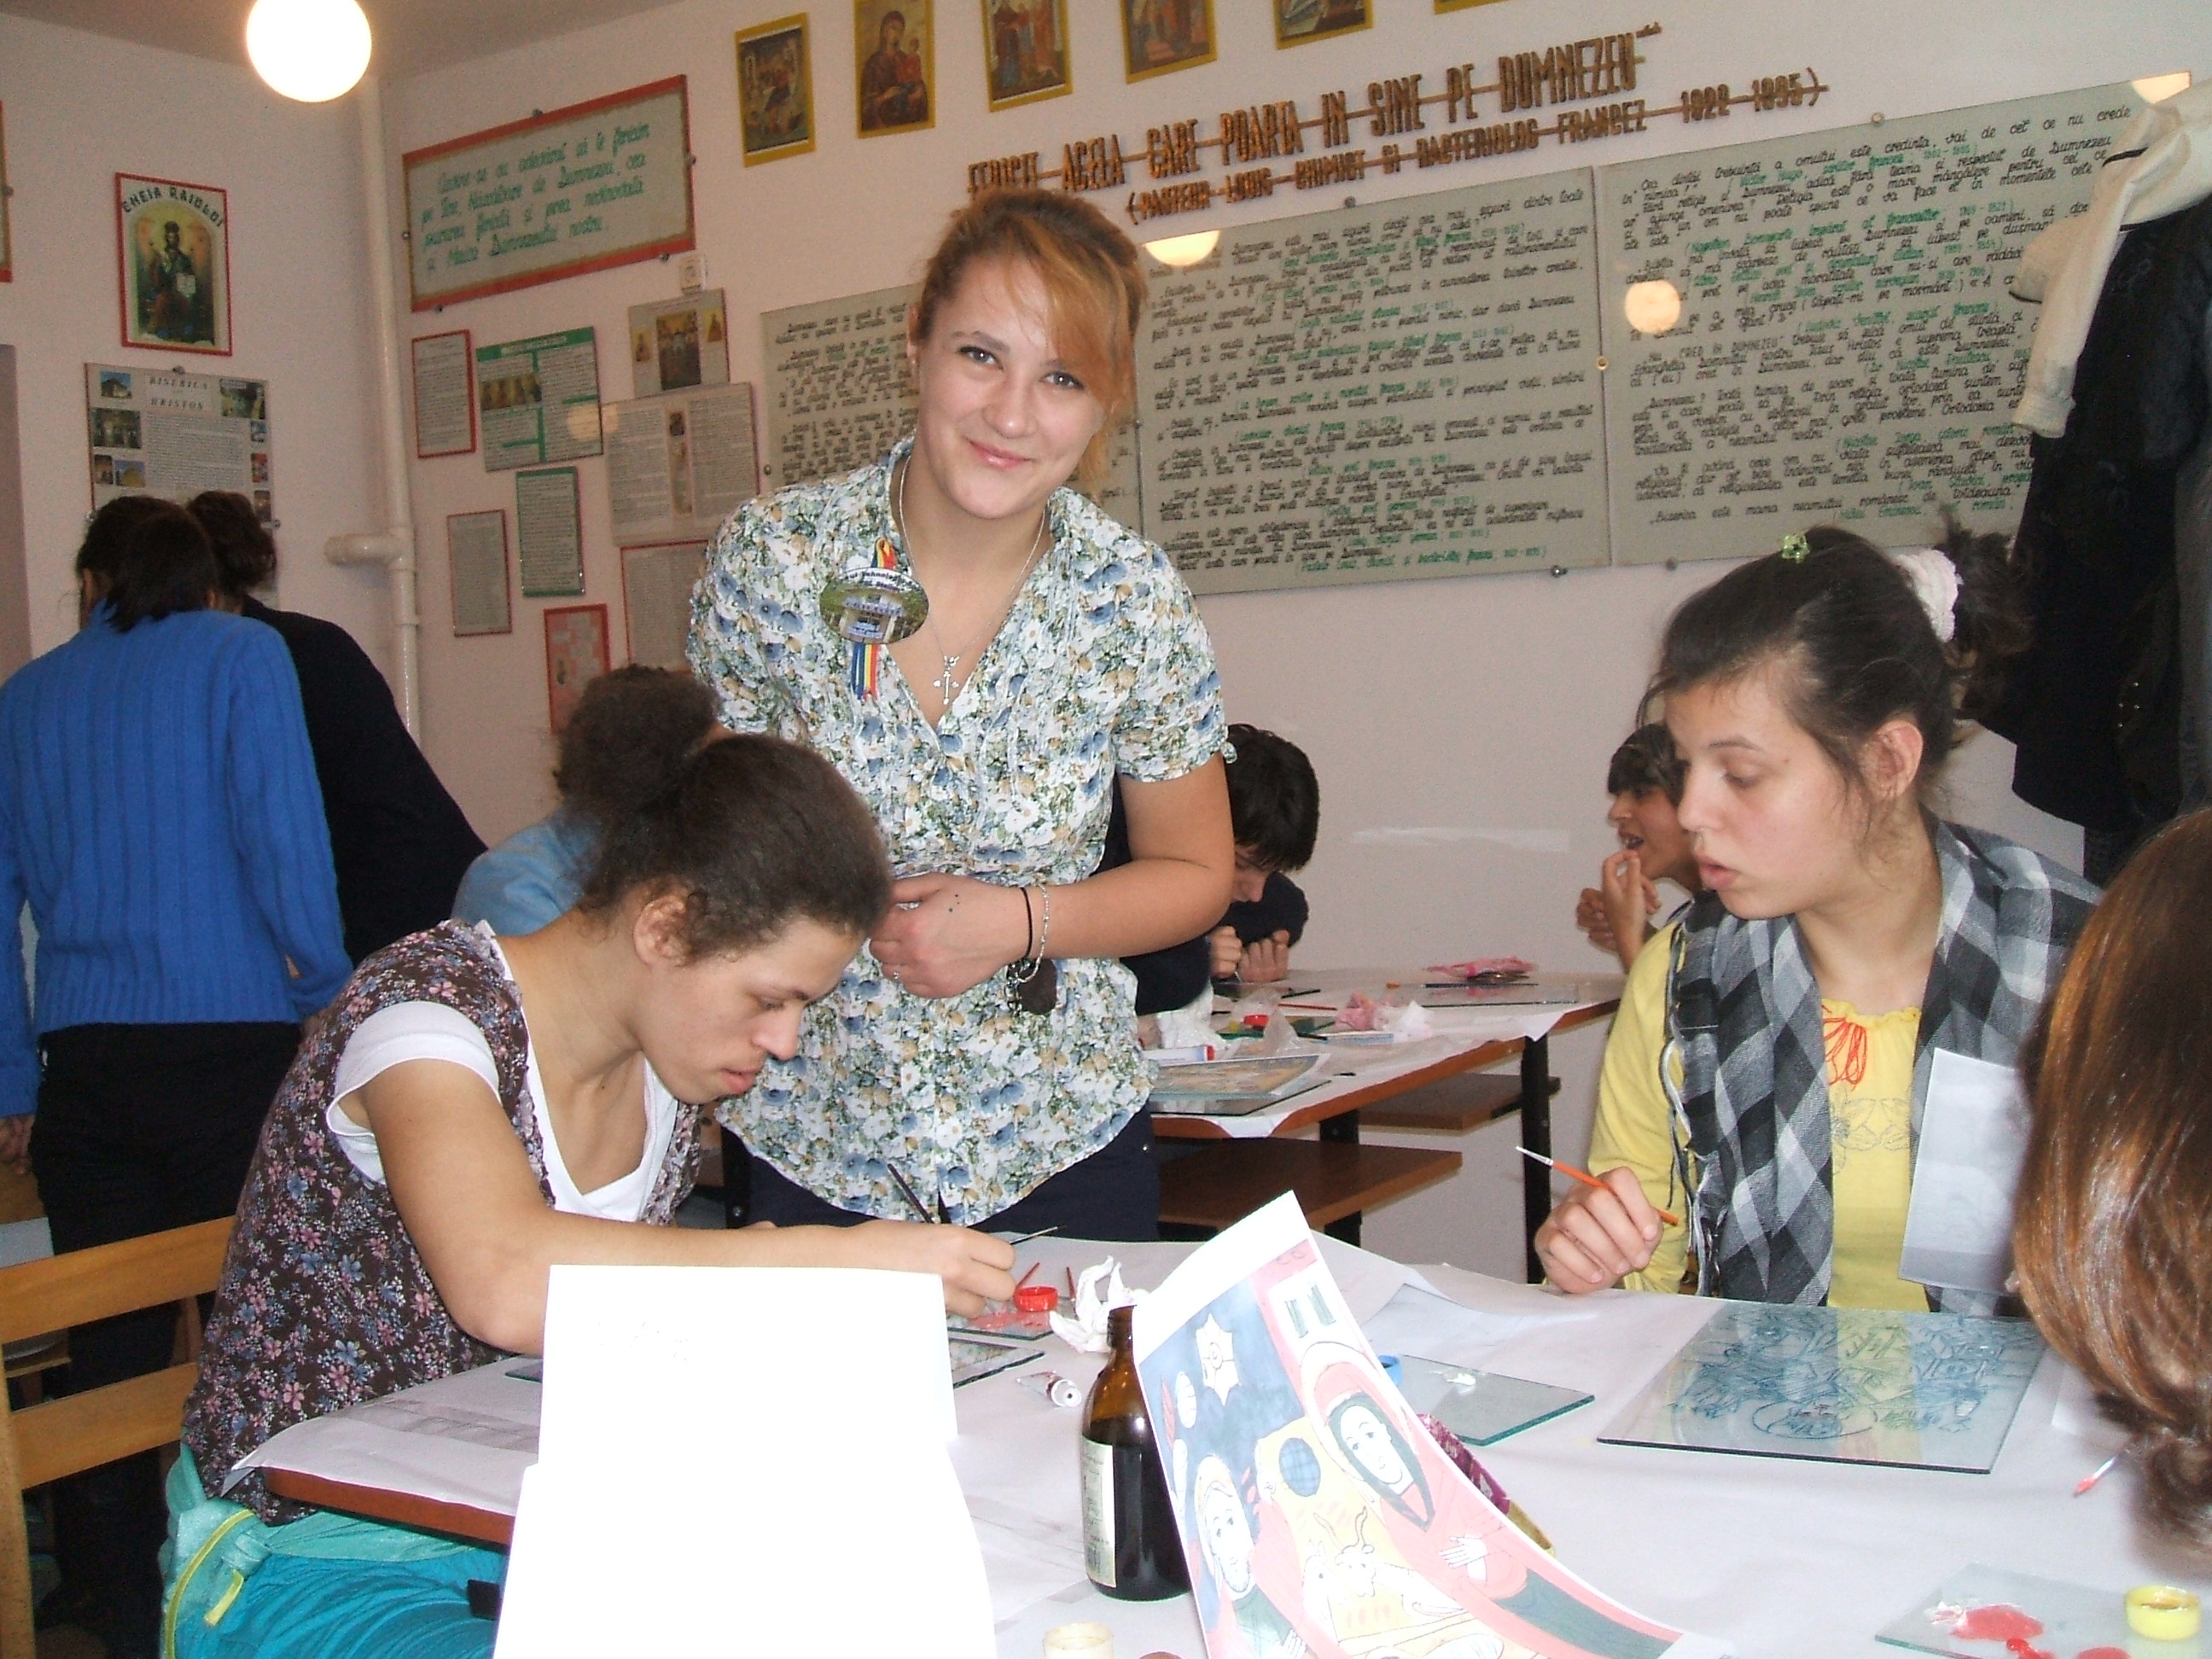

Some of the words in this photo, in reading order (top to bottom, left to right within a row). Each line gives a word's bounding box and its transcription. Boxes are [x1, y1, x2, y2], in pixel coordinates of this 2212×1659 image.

[1146, 119, 1202, 179] CARE
[1321, 90, 1350, 148] IN
[1368, 73, 1425, 137] SINE
[1447, 63, 1479, 124] PE
[1499, 32, 1637, 114] DUMNEZEU
